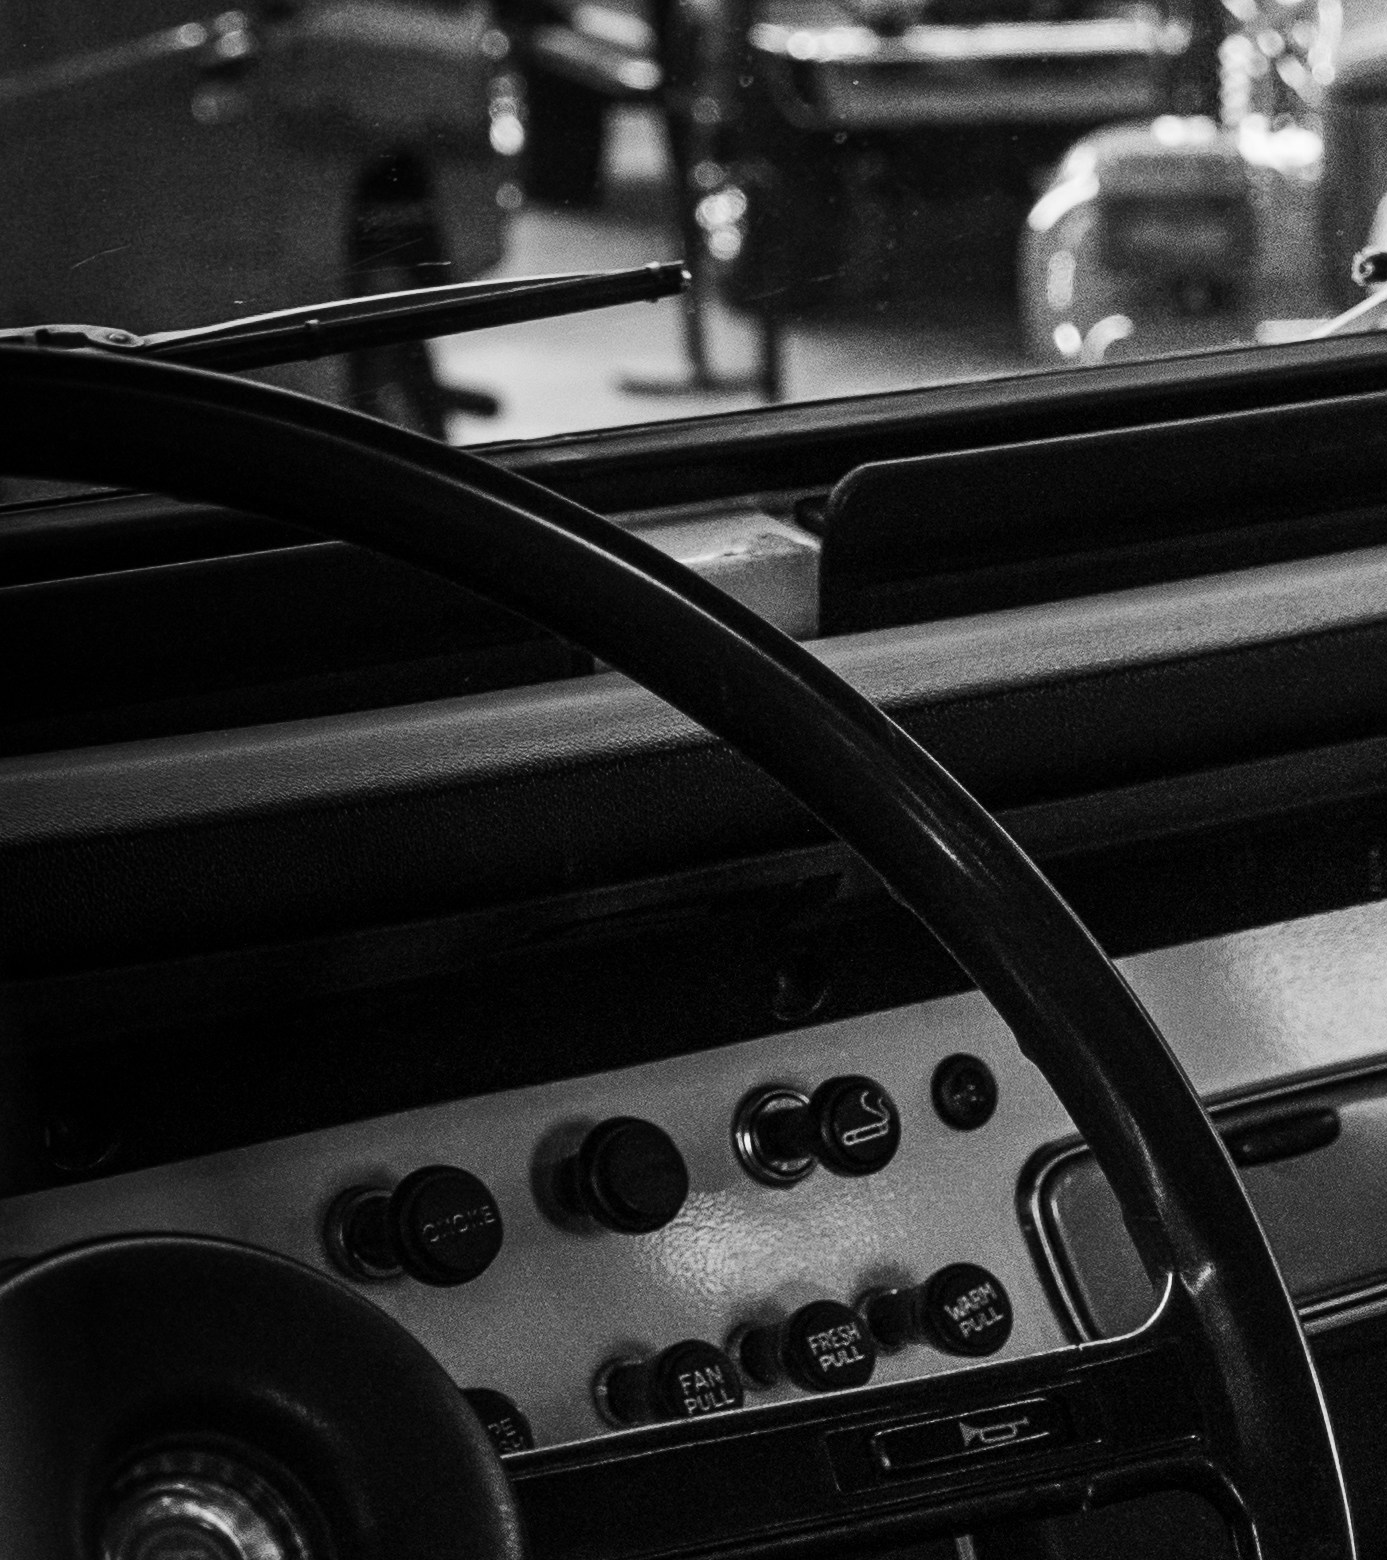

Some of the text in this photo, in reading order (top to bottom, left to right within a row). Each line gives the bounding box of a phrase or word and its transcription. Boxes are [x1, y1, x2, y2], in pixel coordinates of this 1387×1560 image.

[423, 1206, 495, 1242] CHOKE
[944, 1282, 998, 1321] WARM
[958, 1306, 1004, 1338] PULL
[807, 1322, 861, 1356] FRESH
[819, 1345, 866, 1373] PULL
[678, 1365, 725, 1395] FAN
[684, 1388, 735, 1416] PULL
